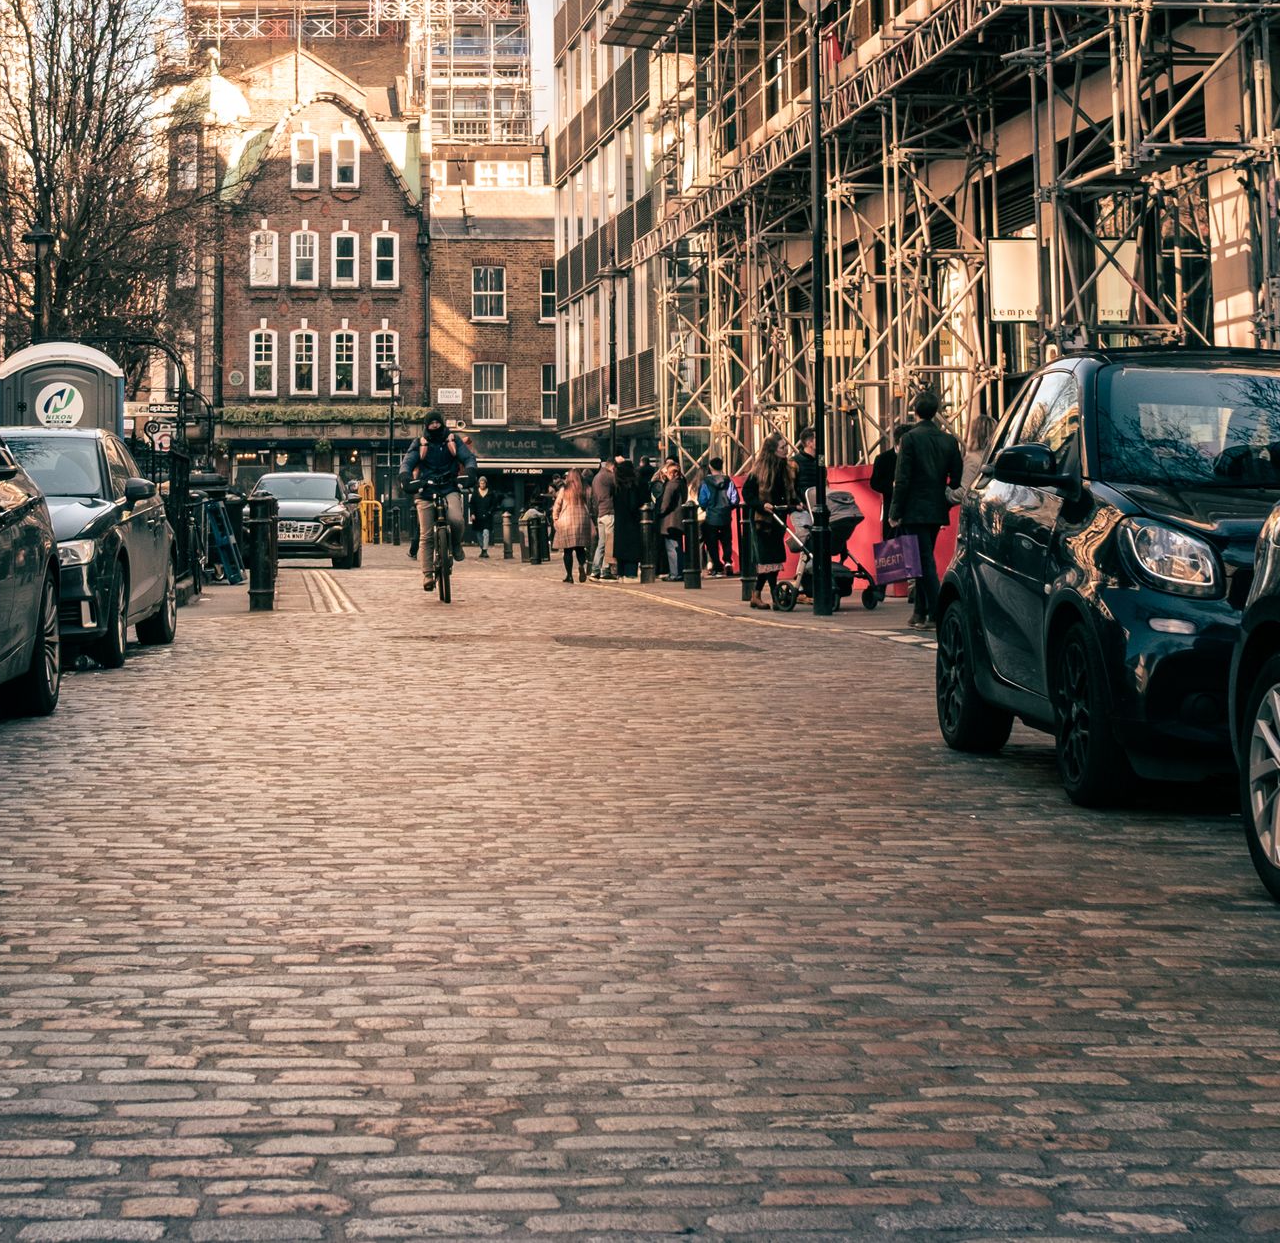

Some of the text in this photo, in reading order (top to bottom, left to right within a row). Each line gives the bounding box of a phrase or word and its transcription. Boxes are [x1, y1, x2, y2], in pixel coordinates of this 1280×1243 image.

[237, 425, 411, 437] THE BLUE POSS
[487, 441, 502, 449] MY
[874, 553, 904, 569] LIBERTY
